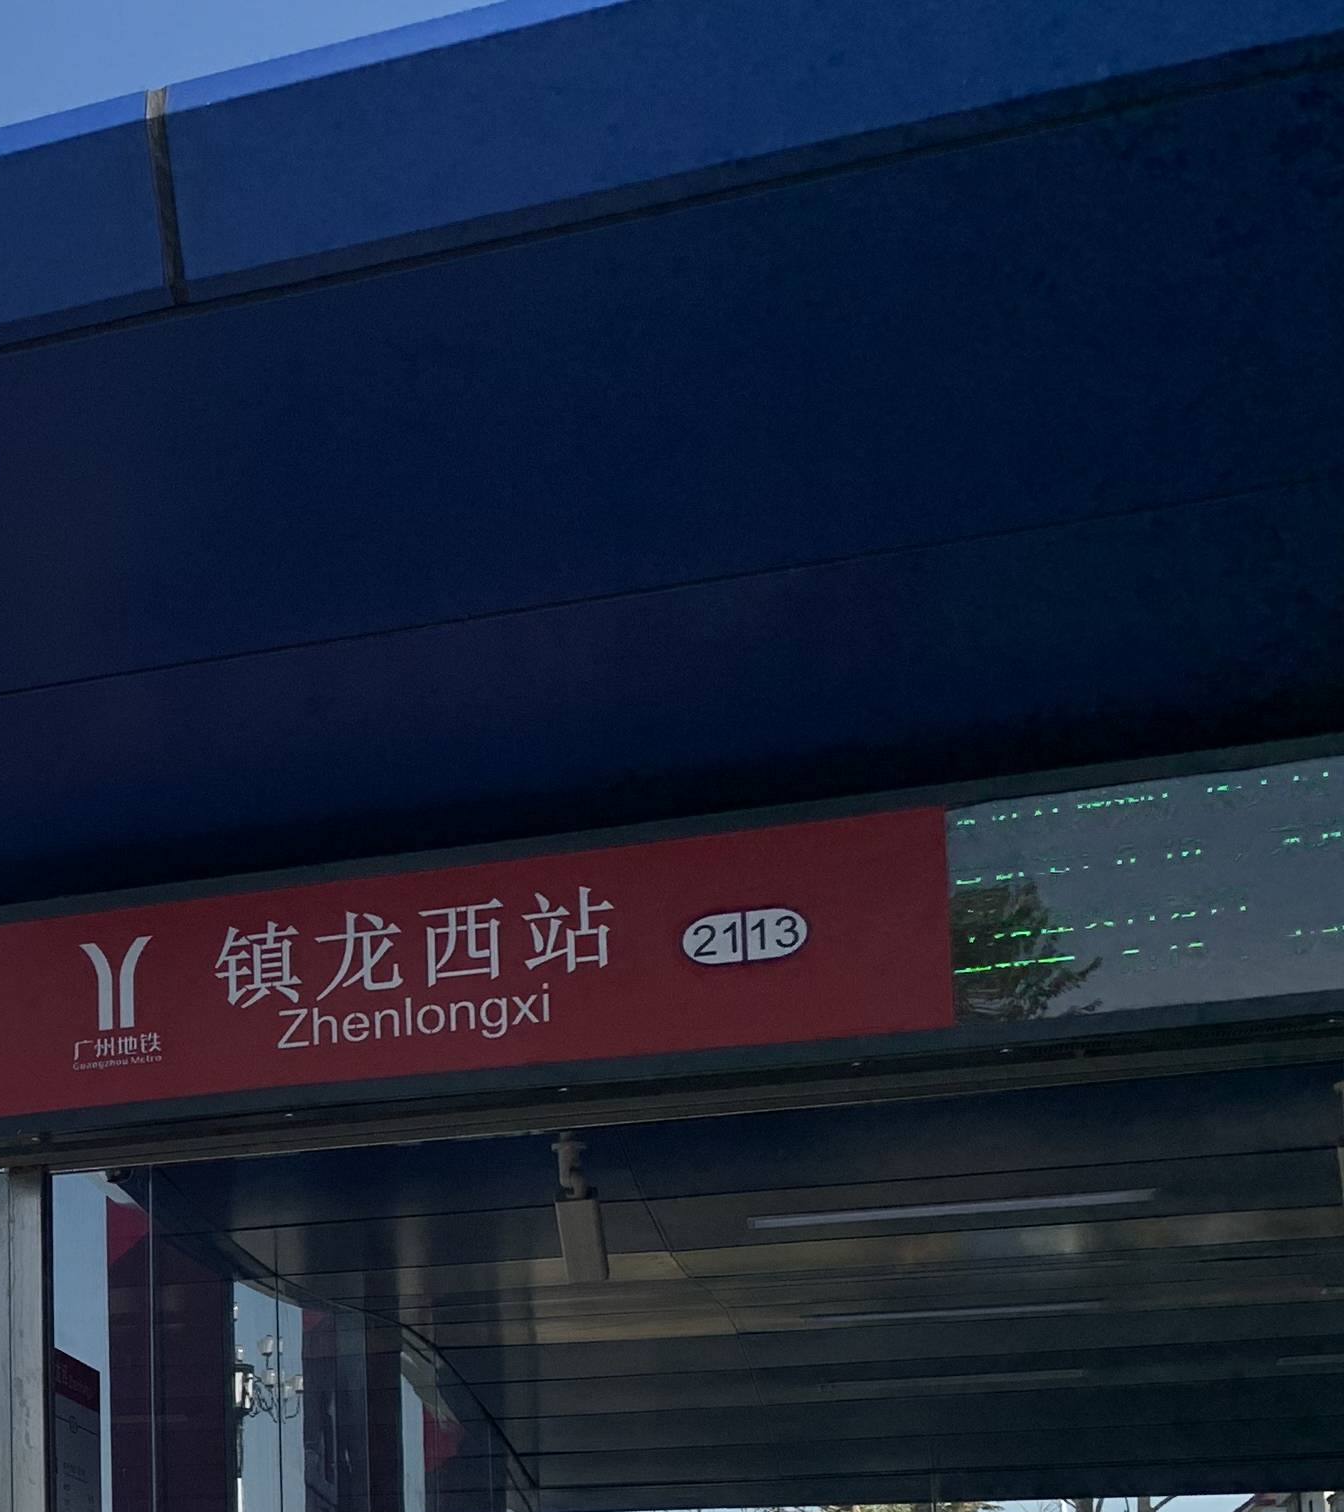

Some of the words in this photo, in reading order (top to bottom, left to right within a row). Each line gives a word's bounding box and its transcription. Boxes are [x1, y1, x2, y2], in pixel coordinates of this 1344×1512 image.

[214, 886, 615, 1009] 镇龙西站
[277, 983, 551, 1050] Zhenlongxi
[72, 1058, 129, 1071] Guangzhou
[130, 1055, 163, 1065] Metro
[73, 1031, 162, 1061] 广州地铁
